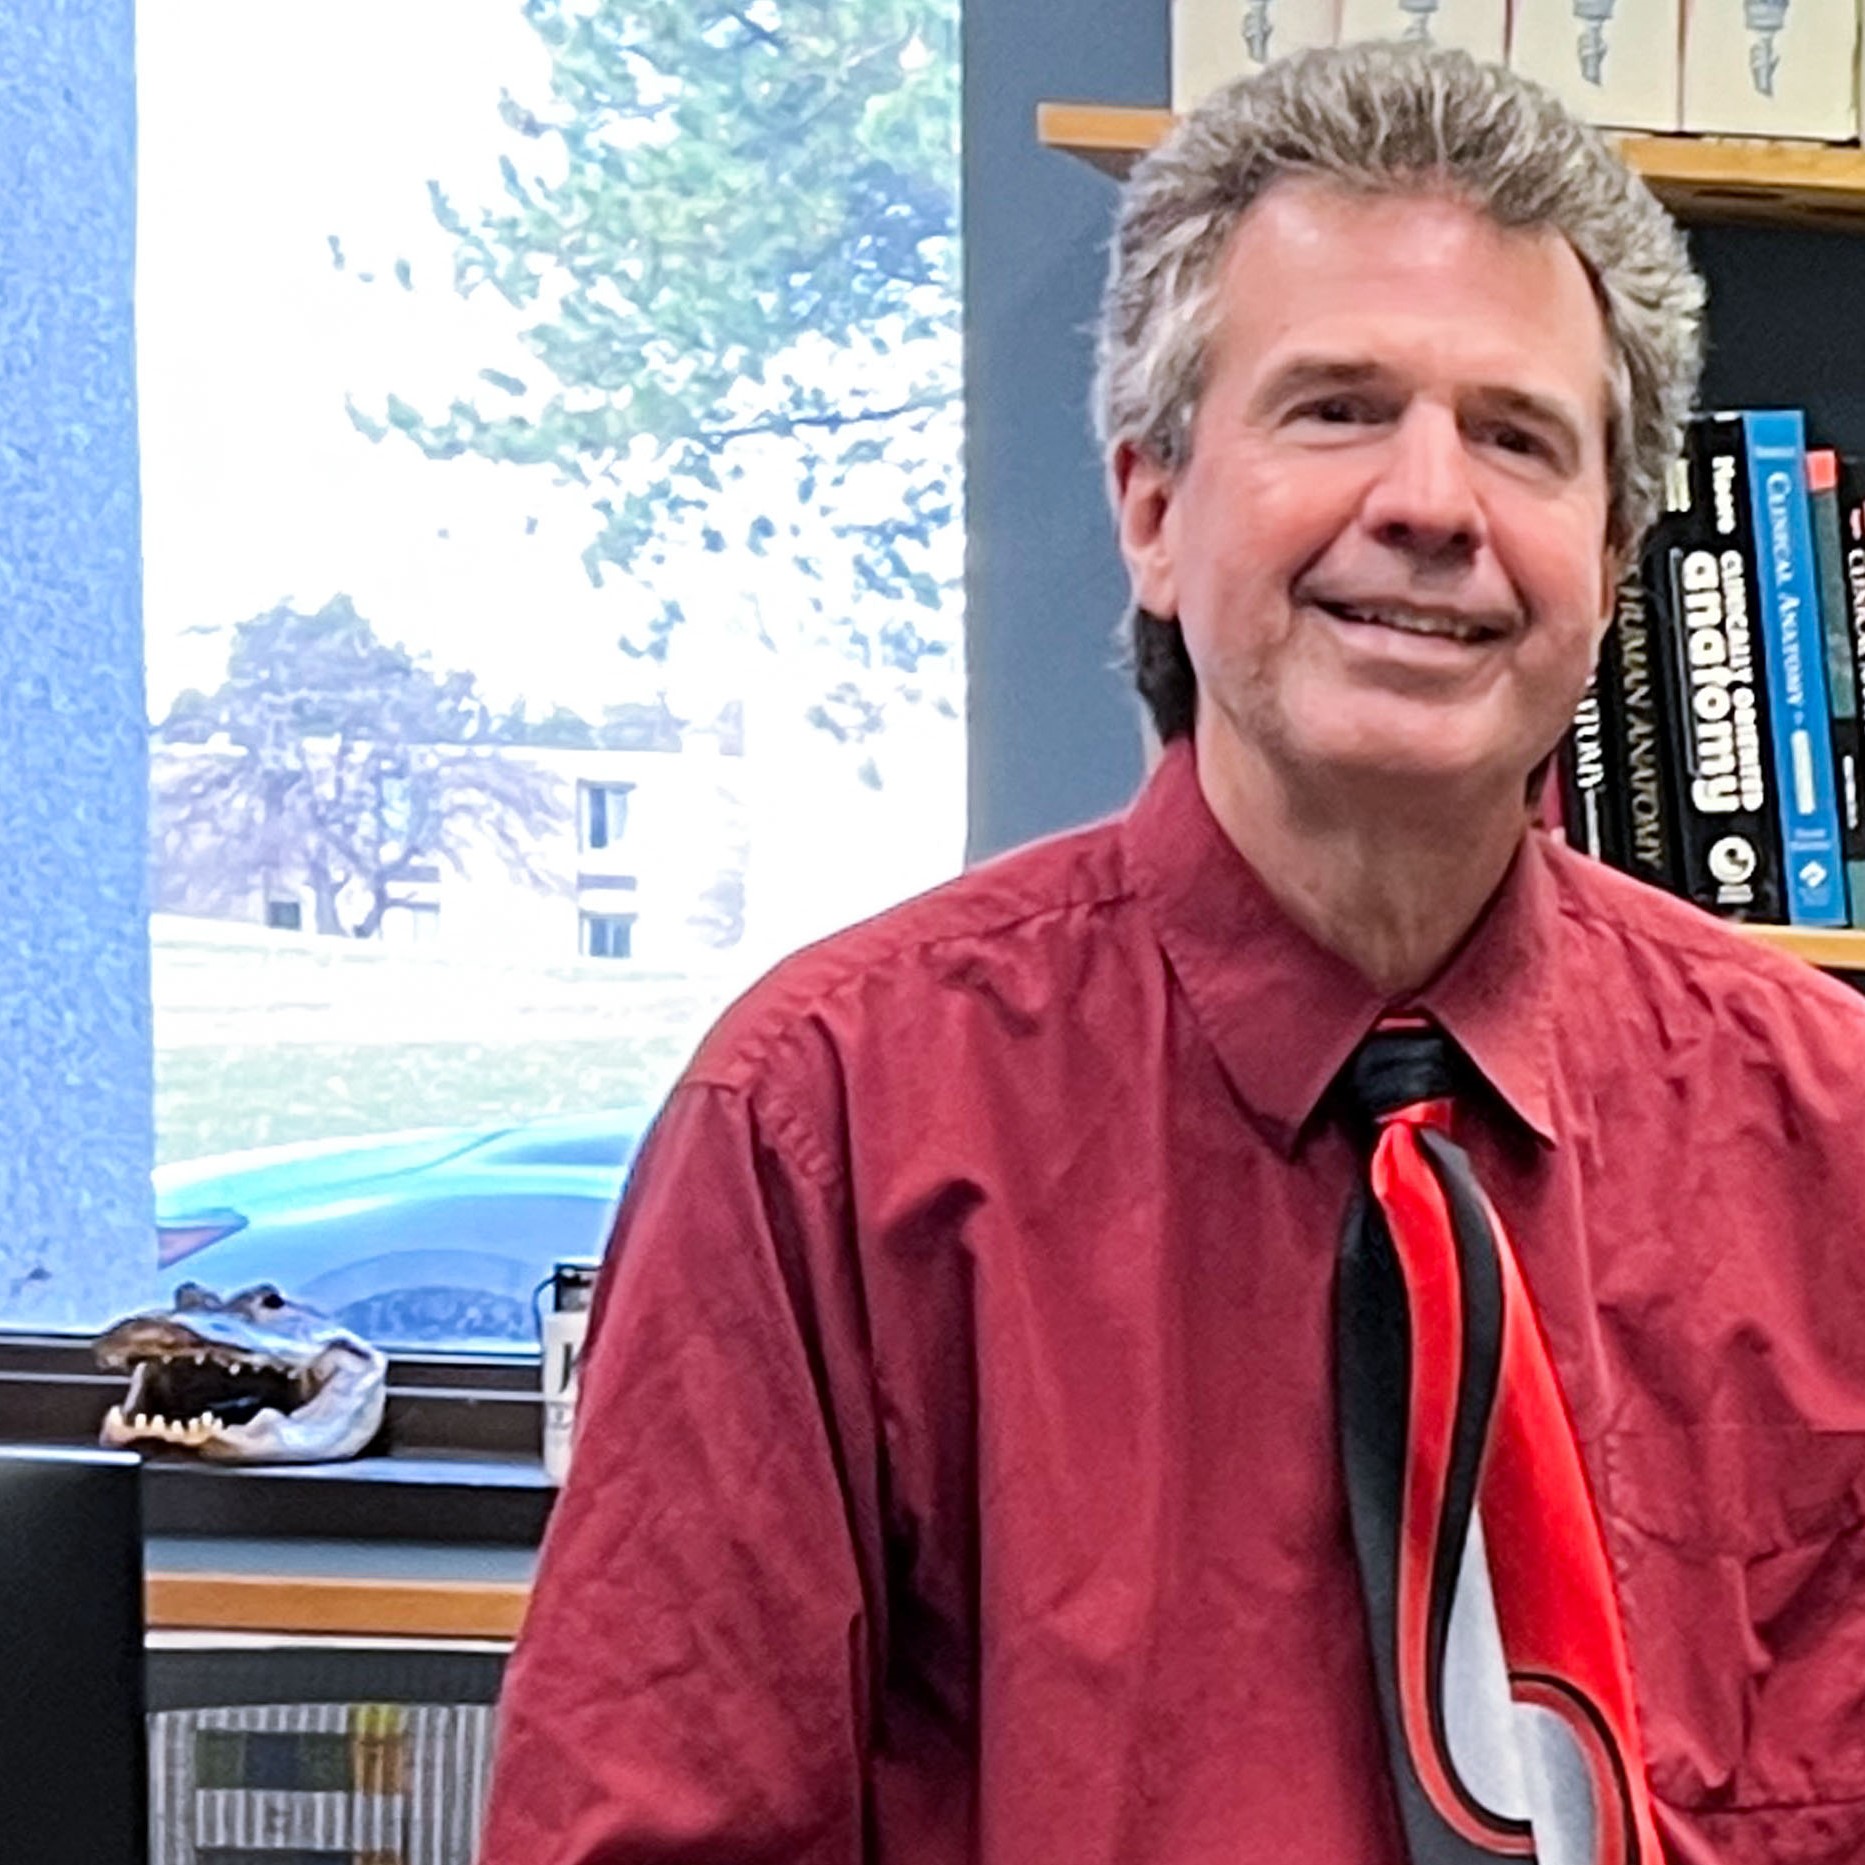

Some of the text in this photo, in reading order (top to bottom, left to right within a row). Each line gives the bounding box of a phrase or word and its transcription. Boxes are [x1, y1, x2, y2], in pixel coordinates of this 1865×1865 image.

[1766, 472, 1794, 587] CLINICAL
[1617, 587, 1663, 869] HUMAN ANATOMY
[1682, 551, 1741, 812] anatomy
[1777, 592, 1804, 707] ANATOMY
